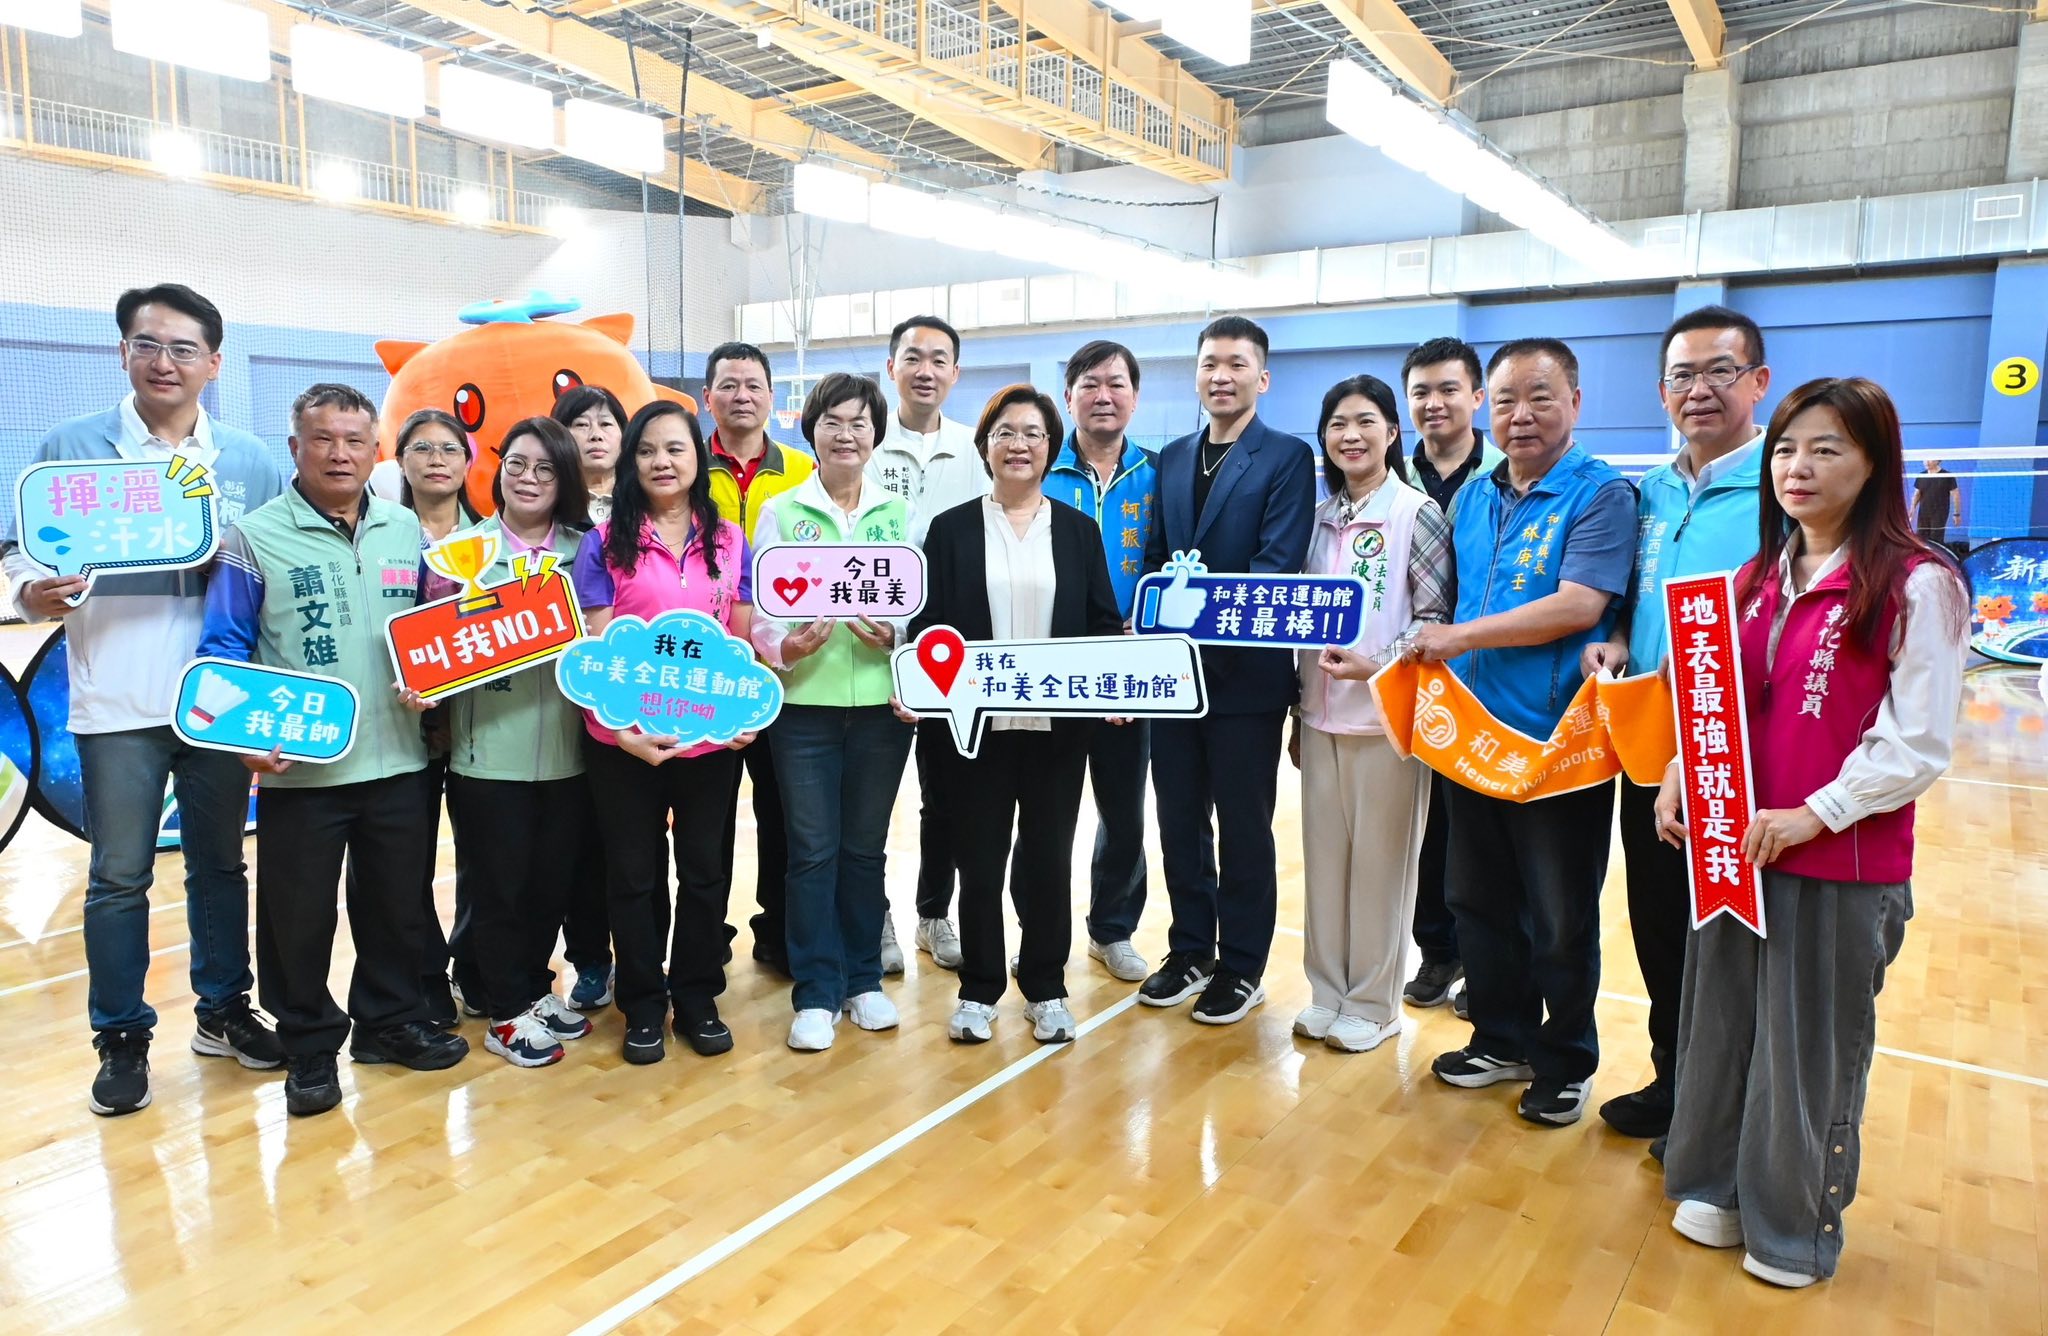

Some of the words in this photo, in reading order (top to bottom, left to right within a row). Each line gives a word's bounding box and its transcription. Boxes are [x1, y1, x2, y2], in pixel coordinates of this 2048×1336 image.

[2005, 363, 2027, 389] 3
[48, 468, 164, 517] 揮灑
[89, 516, 194, 557] 汗水
[1534, 512, 1560, 575] 和美鎮長
[843, 555, 891, 580] 今日
[1351, 558, 1372, 582] 陳
[1372, 549, 1388, 612] 立法委員
[328, 561, 353, 627] 彰化縣議員
[829, 578, 907, 606] 我最美
[1212, 582, 1354, 608] 和美全民運動館
[287, 564, 339, 666] 蕭文雄
[1215, 607, 1345, 640] 我最棒!!
[408, 602, 568, 670] 叫我NO.1
[654, 633, 704, 659] 我在
[975, 652, 1017, 671] 我在
[1797, 603, 1849, 719] 彰化縣議員
[268, 684, 327, 716] 今日
[639, 692, 717, 720] 想你呦
[245, 708, 341, 745] 我最帥
[1680, 593, 1741, 886] 地表最強就是我
